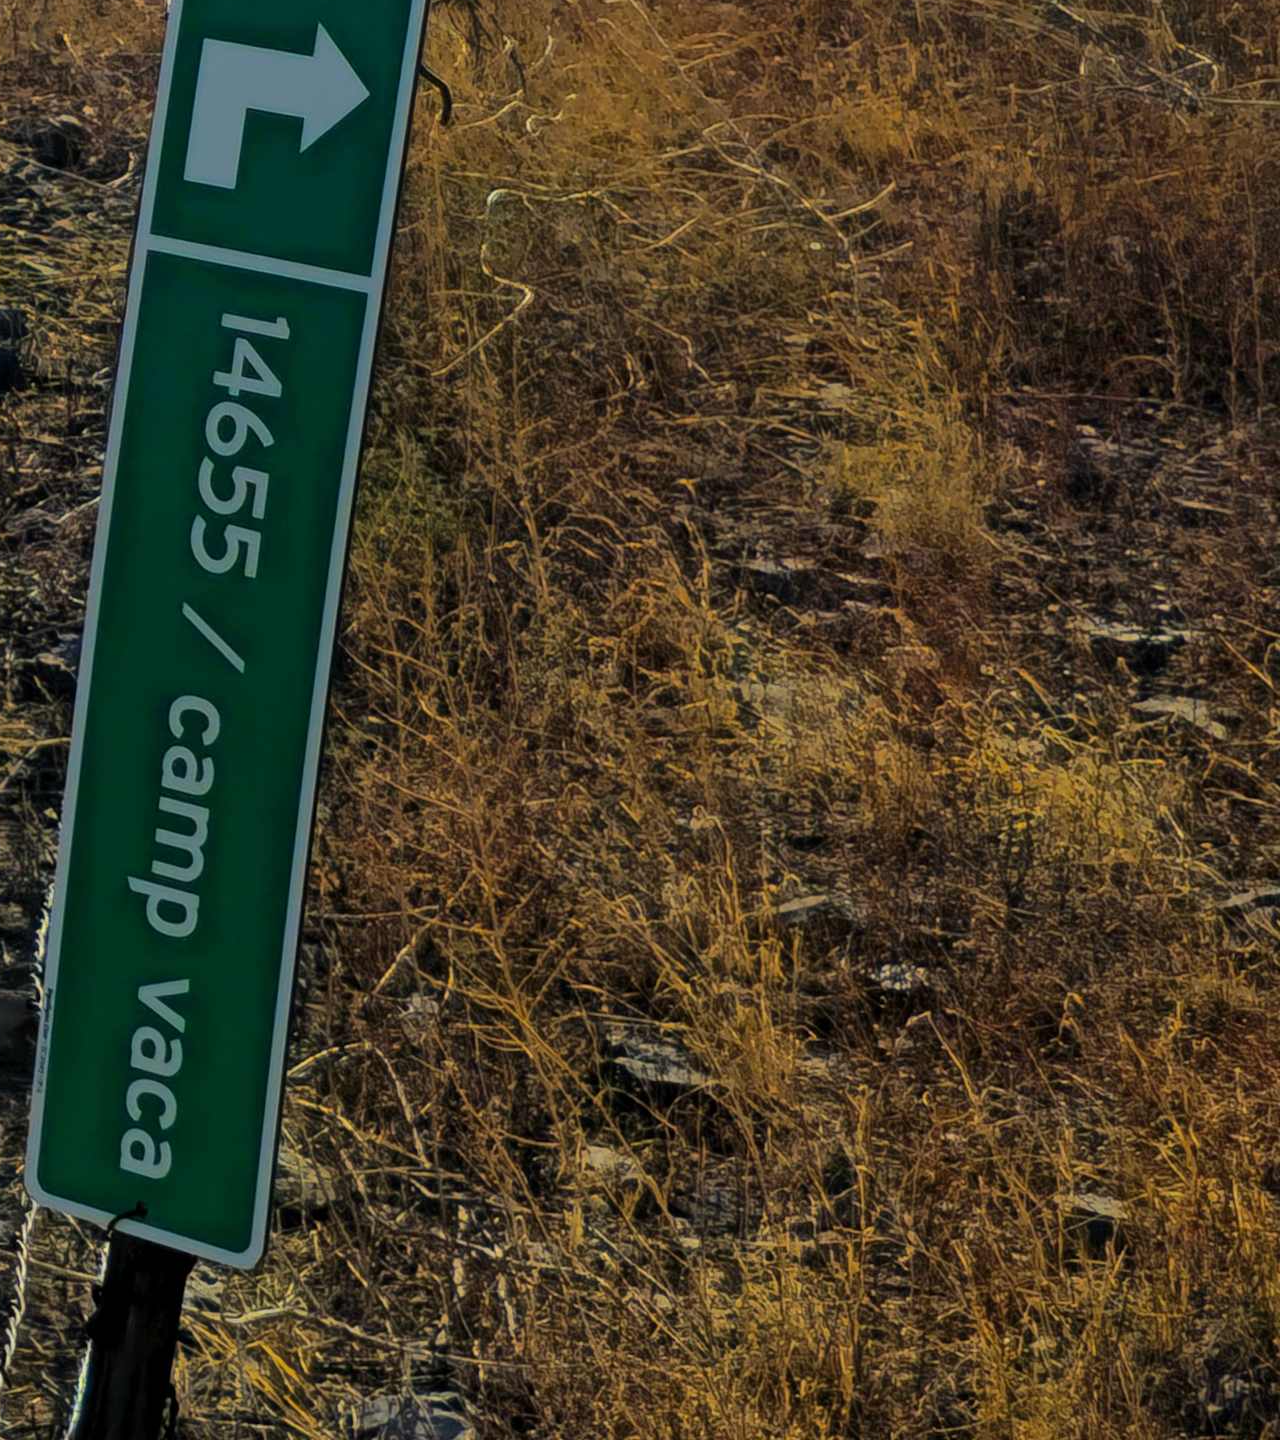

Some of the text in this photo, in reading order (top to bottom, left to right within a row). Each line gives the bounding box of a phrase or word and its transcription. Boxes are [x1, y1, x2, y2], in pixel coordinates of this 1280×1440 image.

[119, 313, 290, 1179] 14655 / camp vaca
